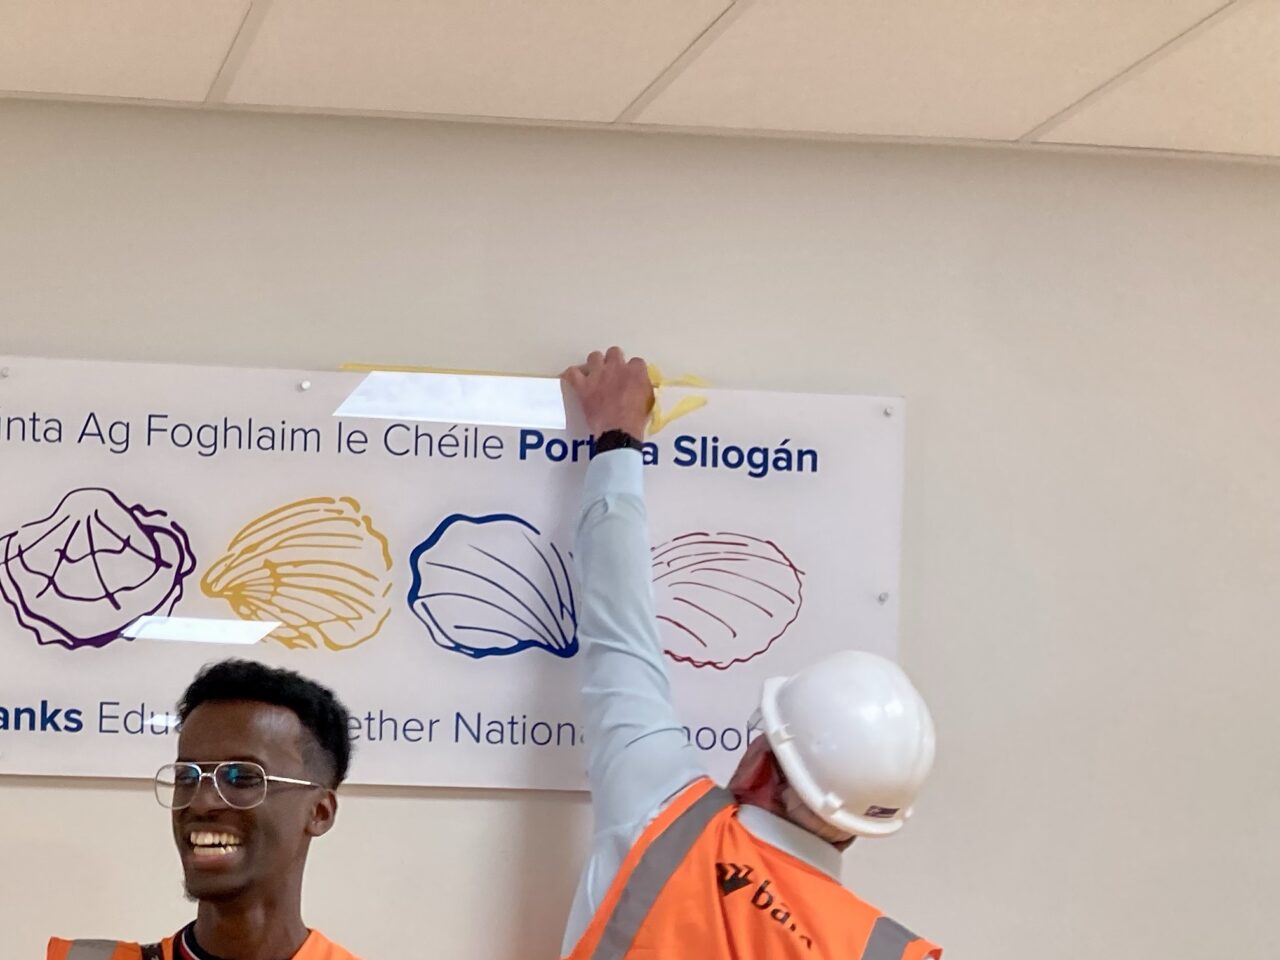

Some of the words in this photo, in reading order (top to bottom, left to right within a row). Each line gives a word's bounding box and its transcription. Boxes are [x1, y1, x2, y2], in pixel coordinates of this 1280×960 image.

[76, 411, 131, 455] Ag
[146, 413, 322, 458] Foghlaim
[336, 420, 370, 455] le
[383, 422, 505, 461] Chéile
[672, 434, 820, 479] Sliogán
[98, 700, 180, 737] Edu
[346, 708, 442, 743] ether
[453, 710, 585, 748] Nation
